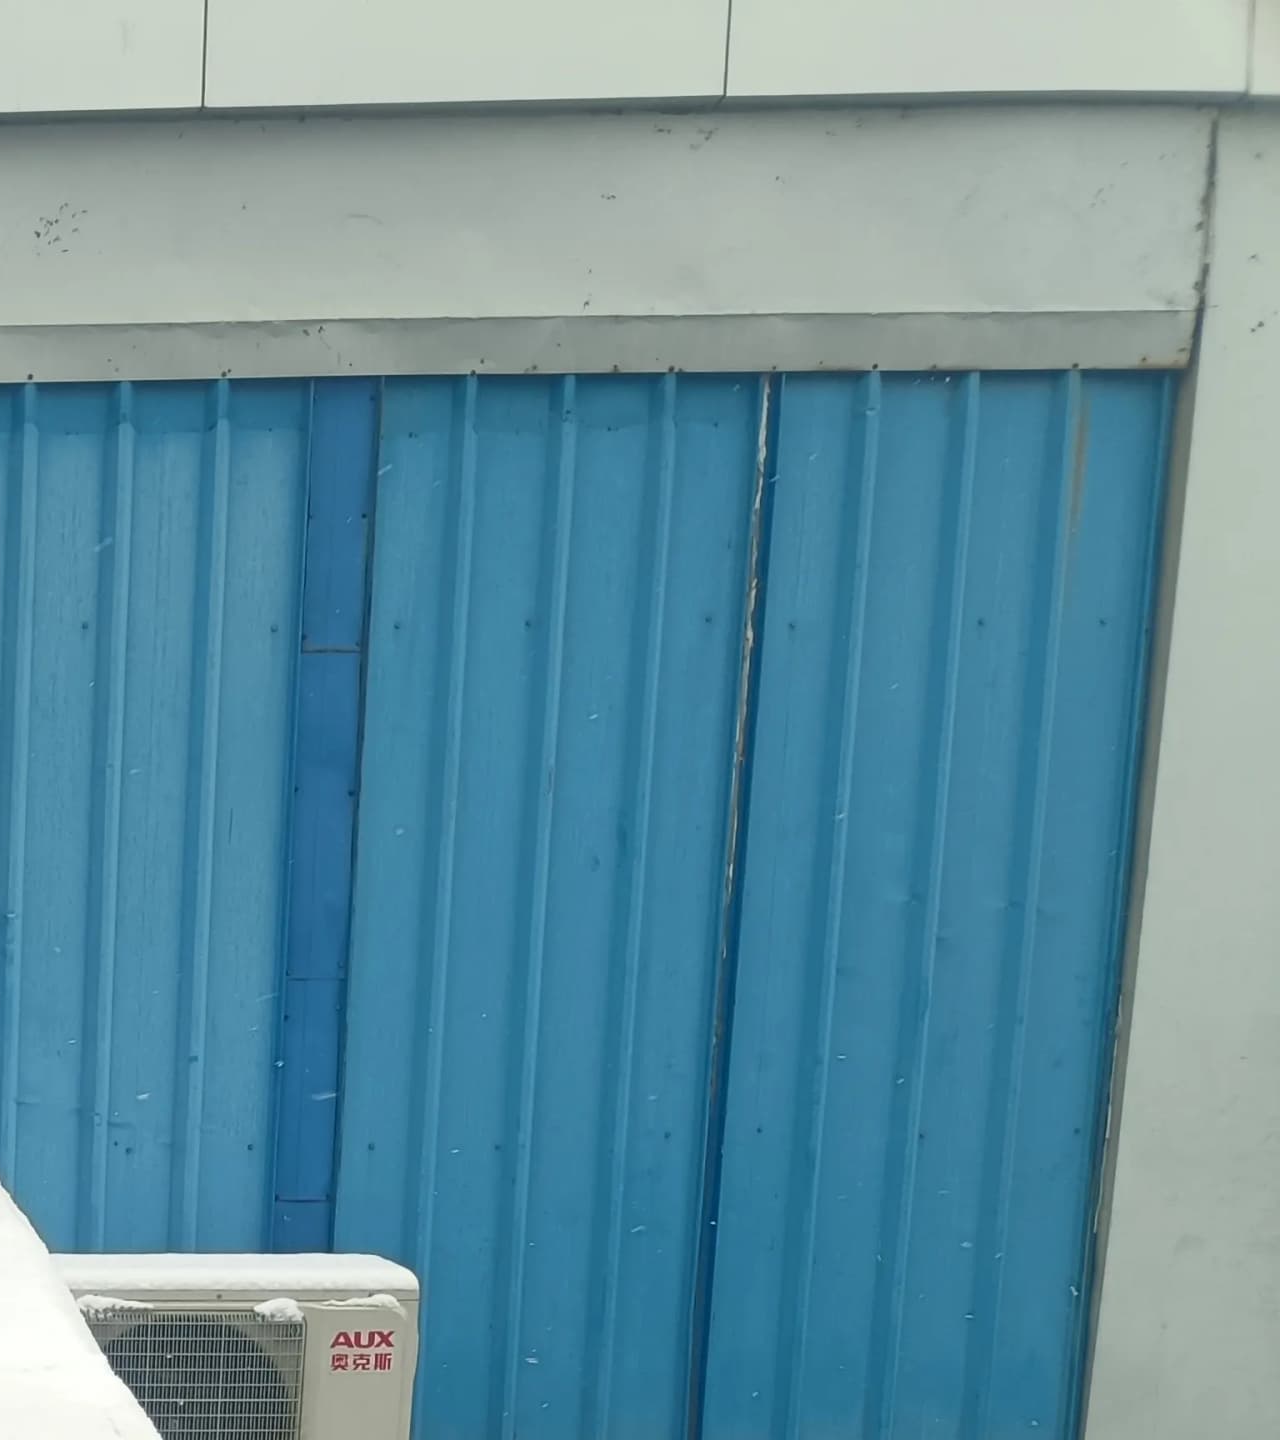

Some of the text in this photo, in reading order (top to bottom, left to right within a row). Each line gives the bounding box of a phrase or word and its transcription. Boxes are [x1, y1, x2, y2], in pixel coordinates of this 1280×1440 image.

[330, 1331, 395, 1349] AUX
[331, 1353, 393, 1371] 奥克斯
